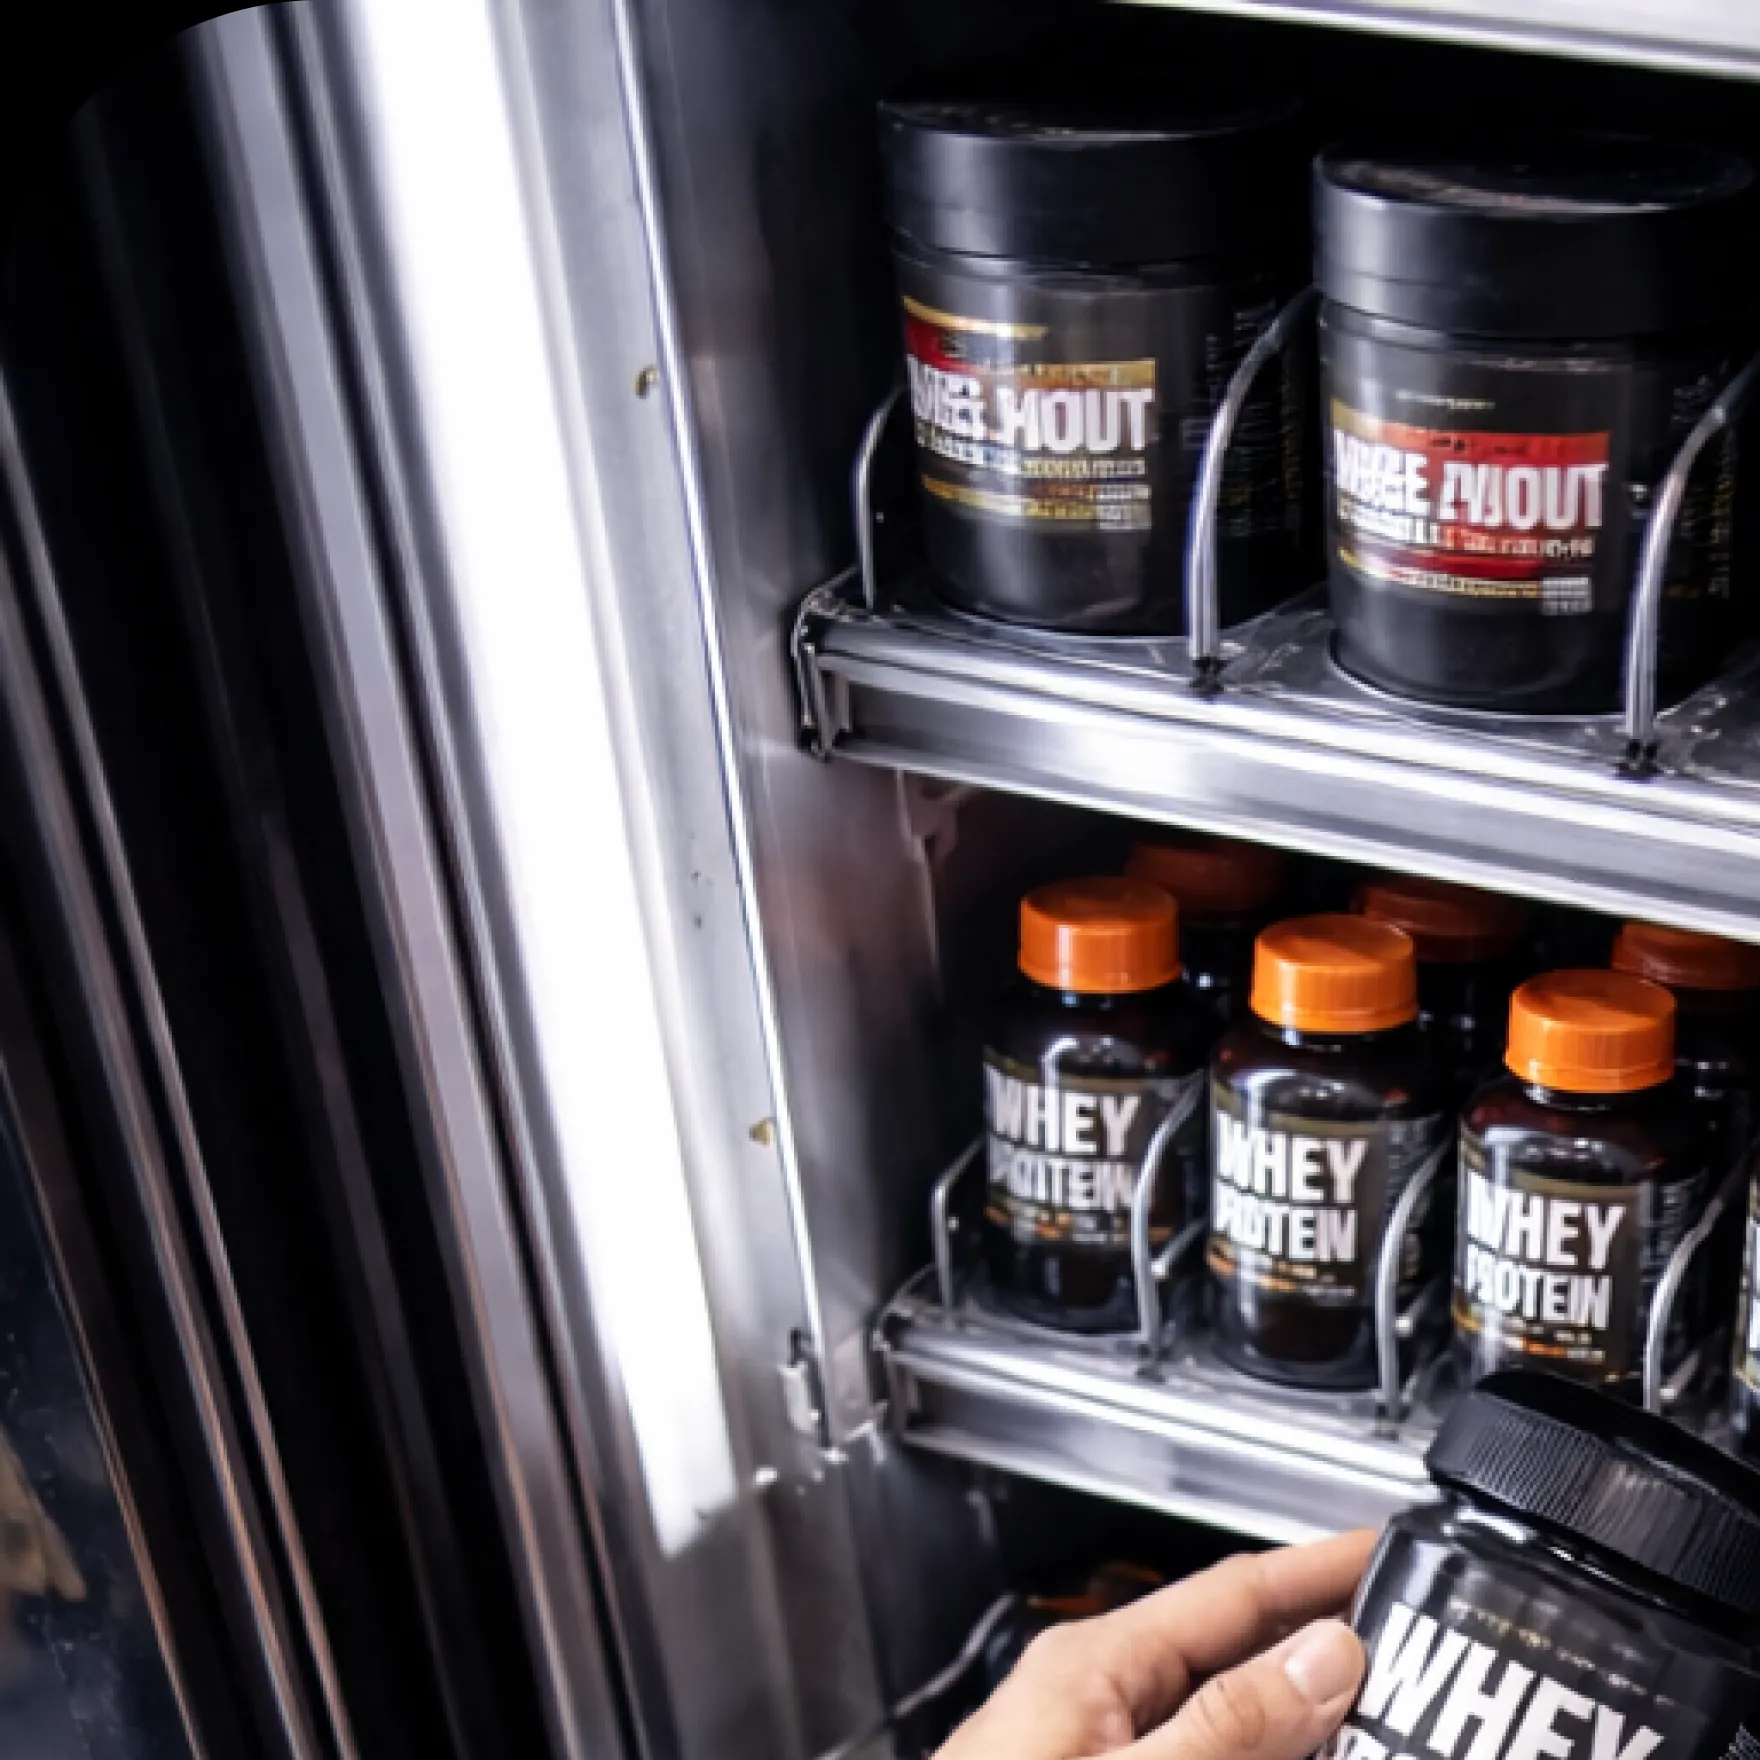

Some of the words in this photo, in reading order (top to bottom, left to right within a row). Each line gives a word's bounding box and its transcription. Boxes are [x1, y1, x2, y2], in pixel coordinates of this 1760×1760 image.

[984, 1061, 1141, 1156] WHEY
[1213, 1109, 1369, 1204] WHEY
[1465, 1170, 1628, 1271] WHEY
